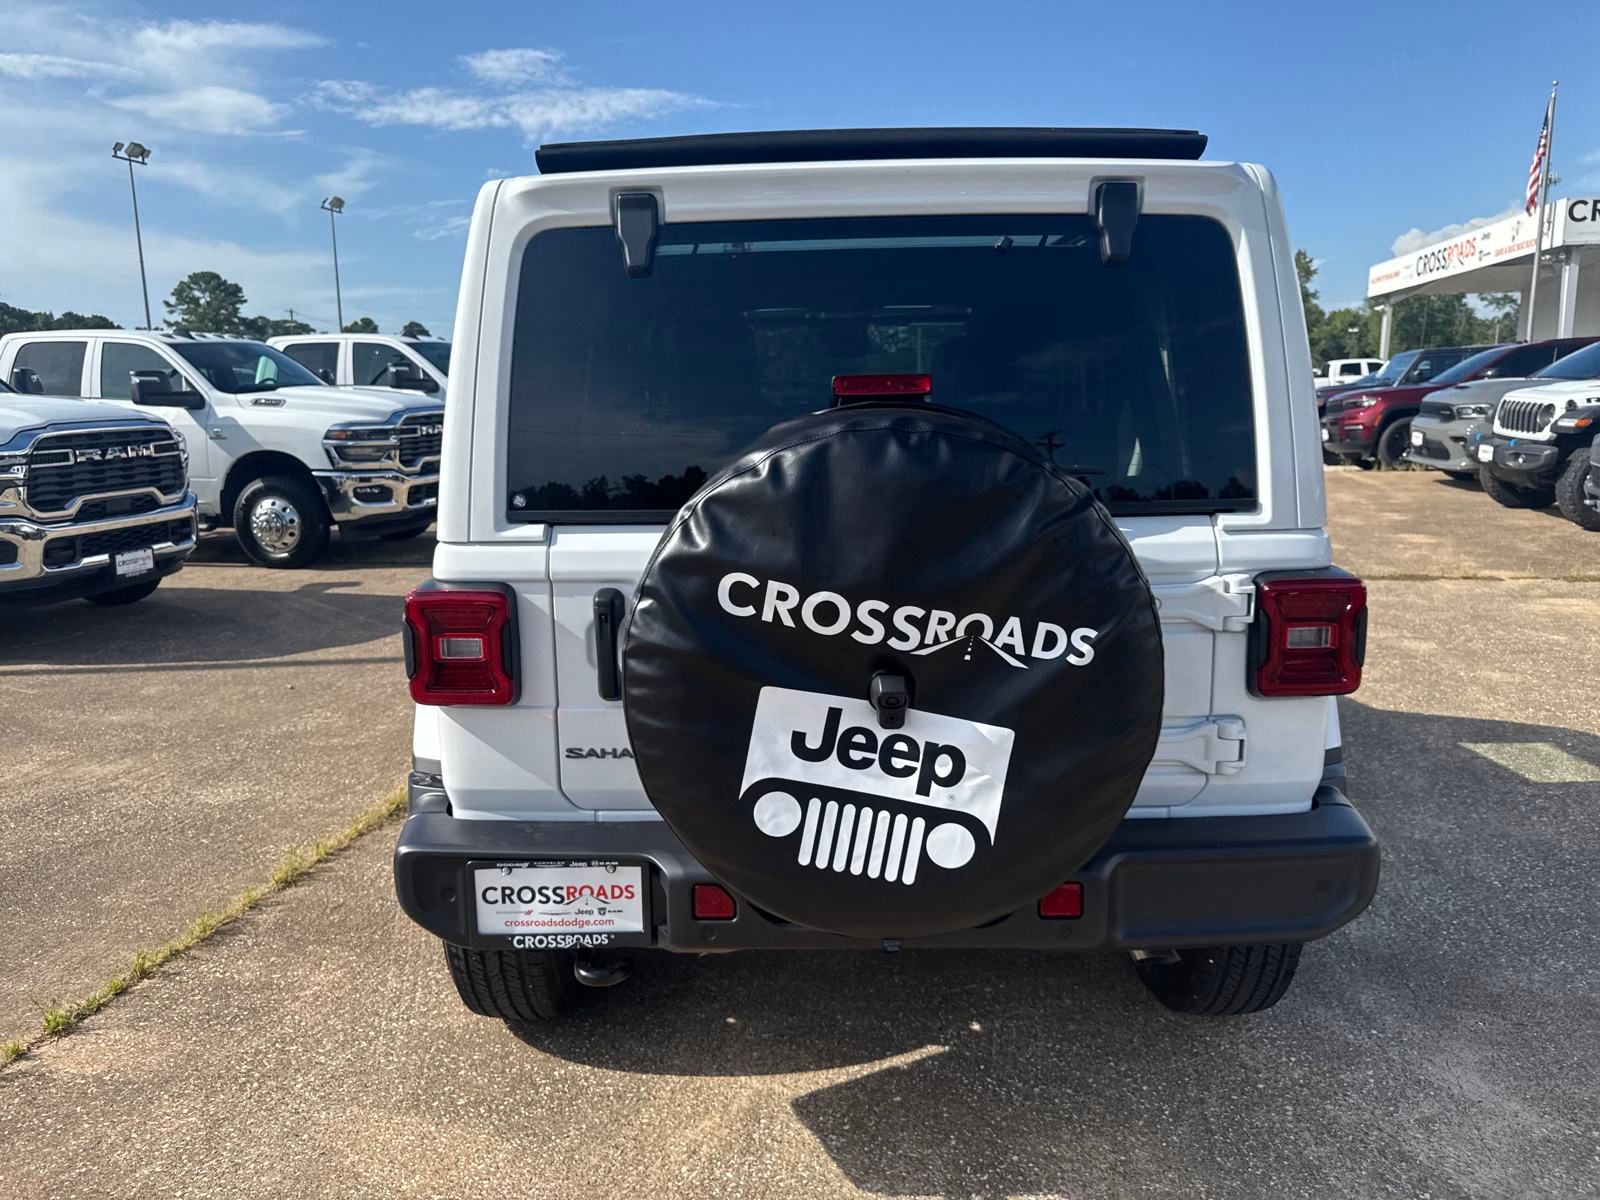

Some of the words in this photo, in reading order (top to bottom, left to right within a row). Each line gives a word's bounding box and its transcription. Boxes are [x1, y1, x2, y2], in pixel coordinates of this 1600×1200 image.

[76, 445, 153, 462] RAM
[717, 572, 1099, 669] CROSSROADS
[790, 706, 967, 797] Jeep
[481, 884, 635, 905] CROSSROADS
[574, 908, 594, 916] Jeep
[504, 918, 615, 929] crossroadsdodge.com
[512, 934, 609, 949] CROSSROADS
